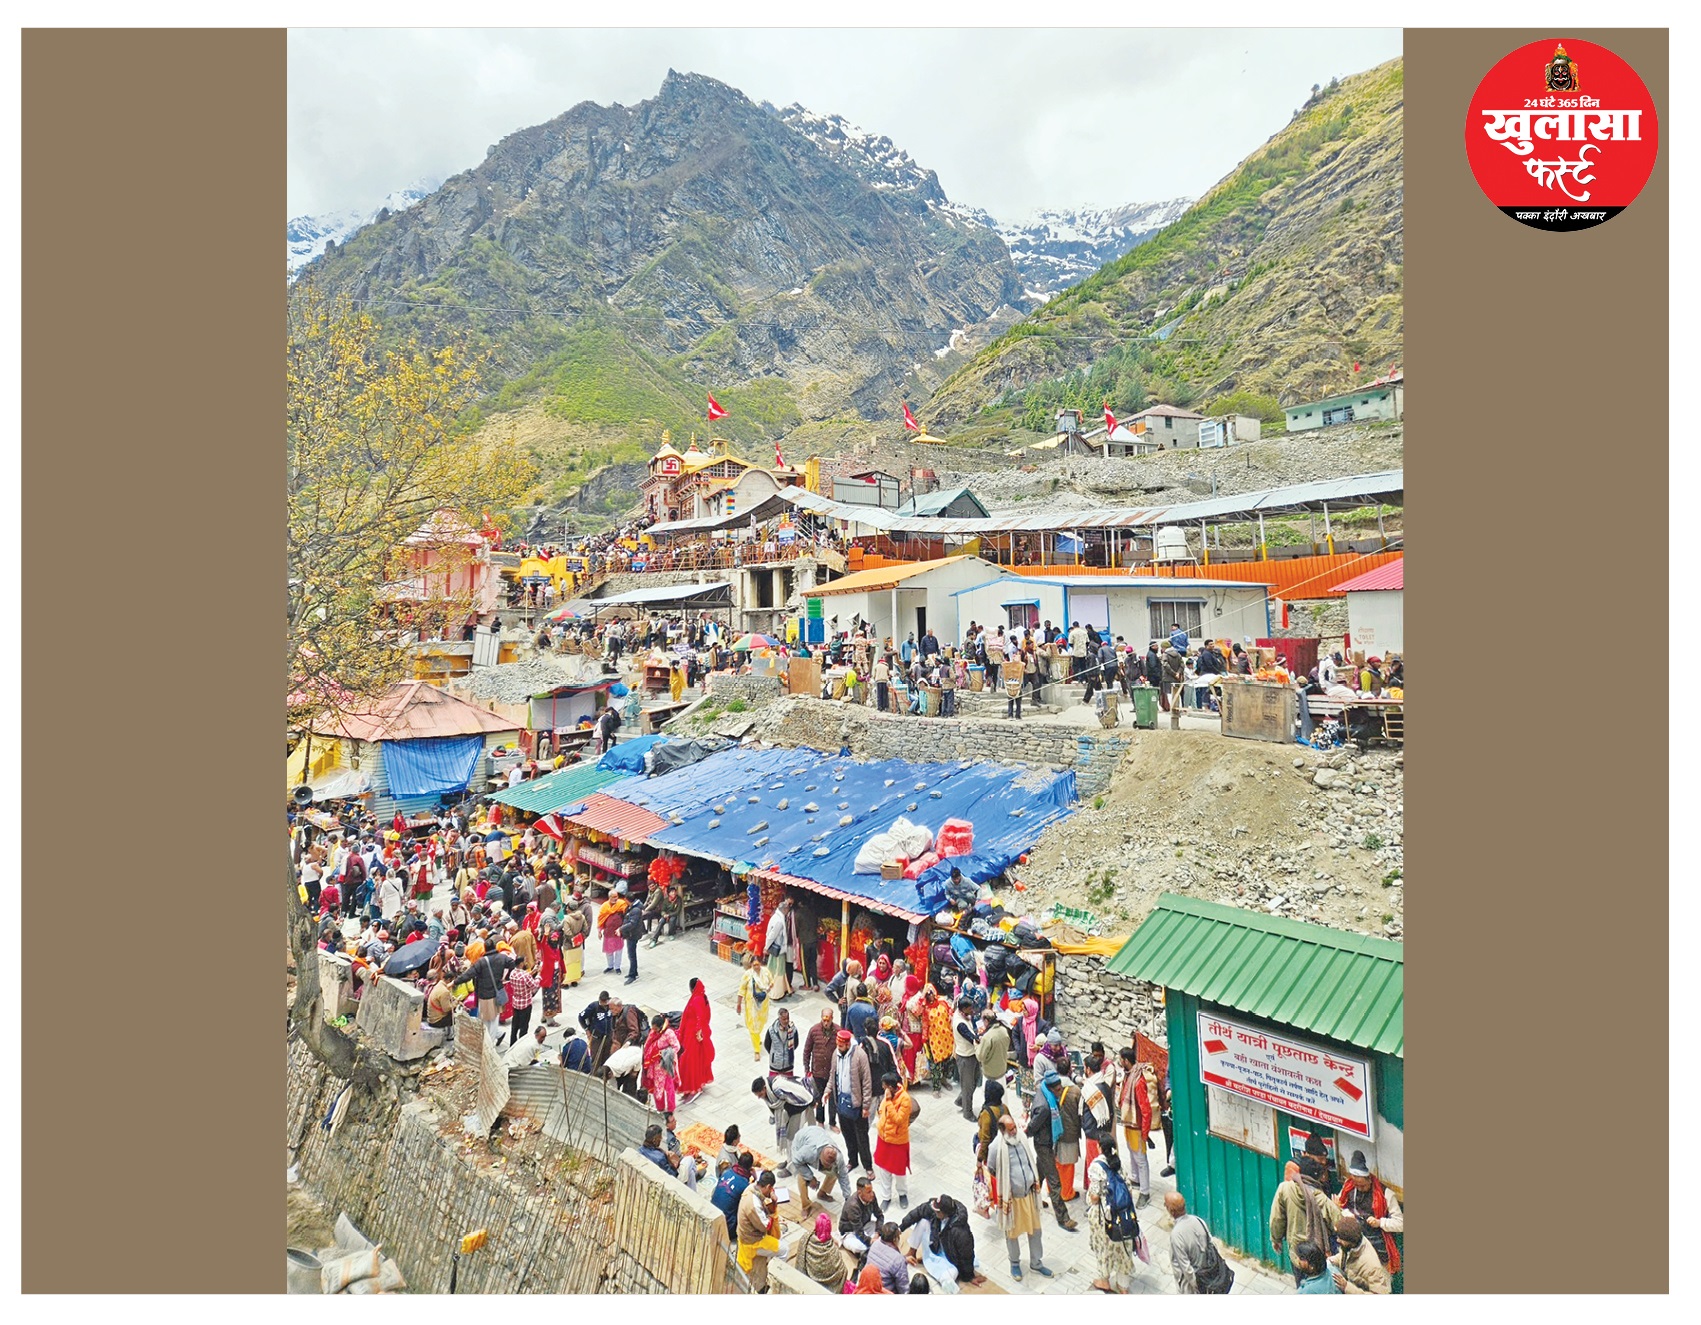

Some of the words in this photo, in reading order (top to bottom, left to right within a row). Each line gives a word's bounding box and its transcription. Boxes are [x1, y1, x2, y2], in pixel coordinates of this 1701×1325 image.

[1208, 1022, 1232, 1039] तीर्थ
[1236, 1032, 1267, 1050] यात्री
[1272, 1042, 1319, 1064] पूछताछ
[1323, 1053, 1354, 1078] केन्द्र
[1249, 1058, 1269, 1070] खाता
[1271, 1063, 1303, 1081] वंशावली
[1305, 1076, 1322, 1087] कक्ष
